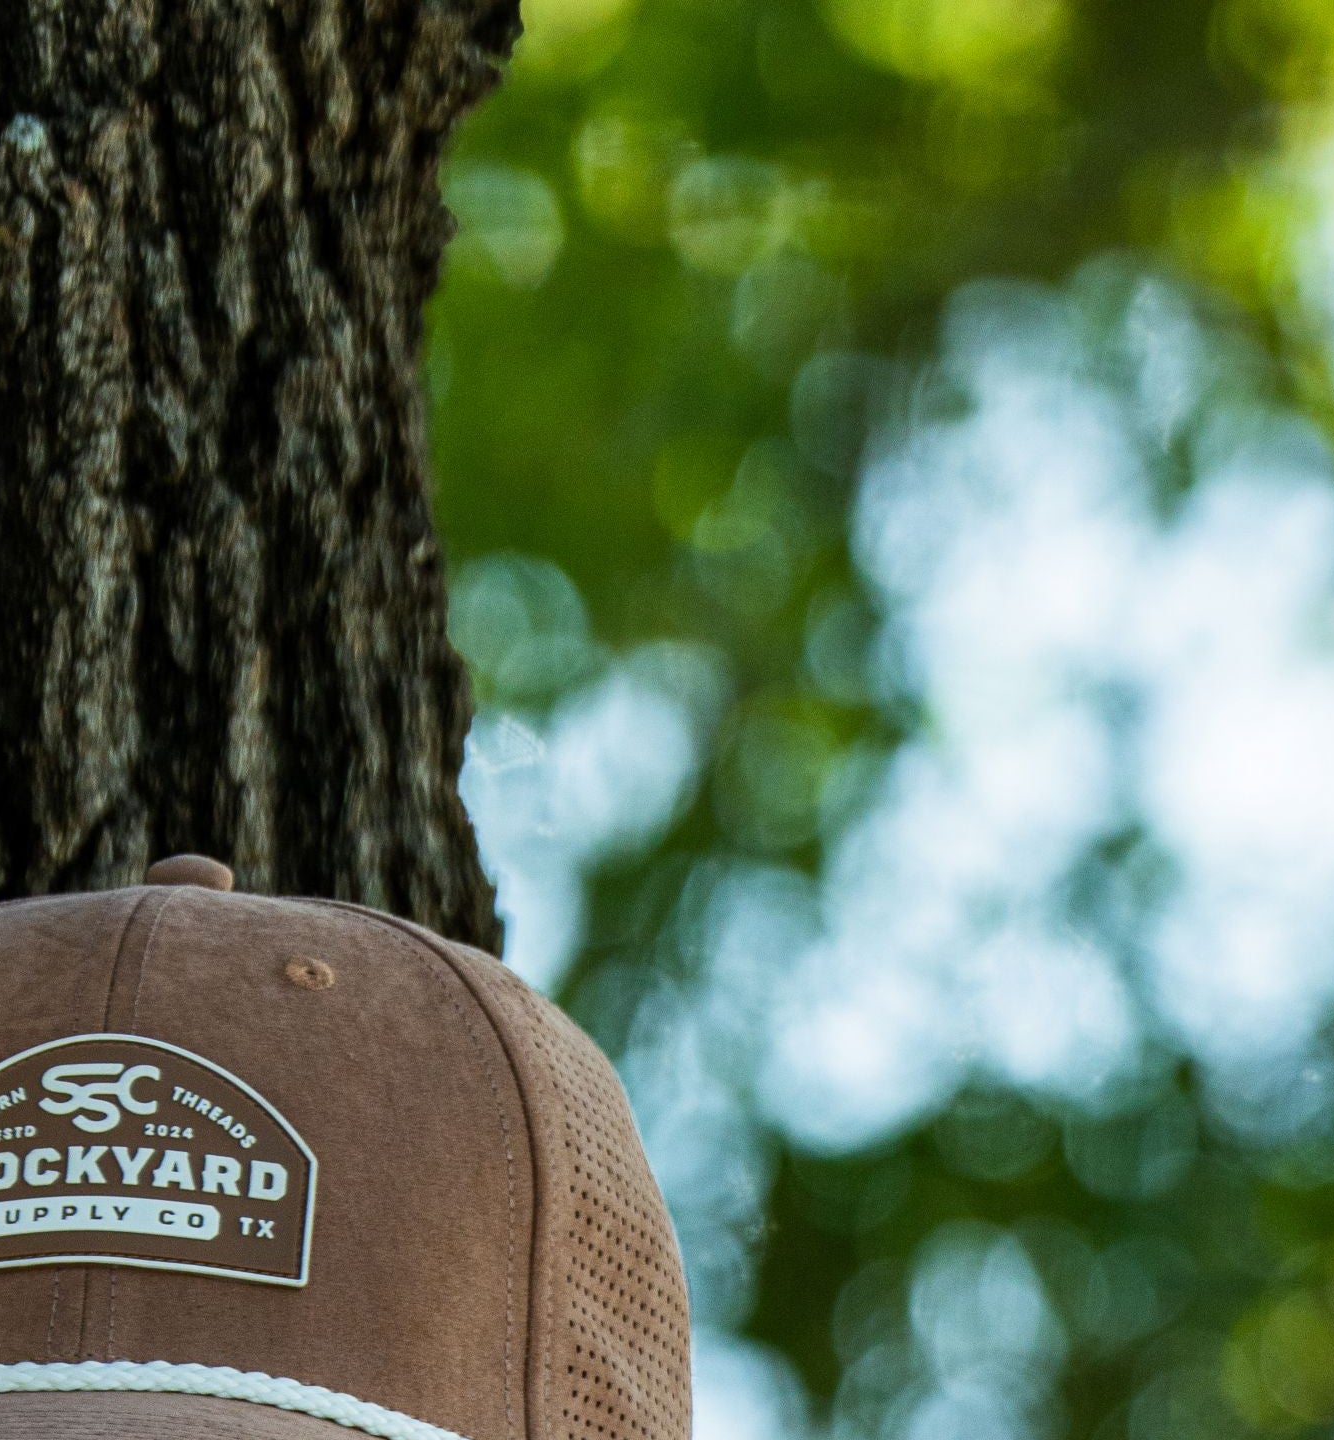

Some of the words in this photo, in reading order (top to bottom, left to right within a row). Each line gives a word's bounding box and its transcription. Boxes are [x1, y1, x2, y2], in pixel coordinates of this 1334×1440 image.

[144, 1123, 194, 1139] 2024
[172, 1086, 257, 1148] THREADS
[158, 1209, 205, 1229] CO
[239, 1215, 275, 1239] TX
